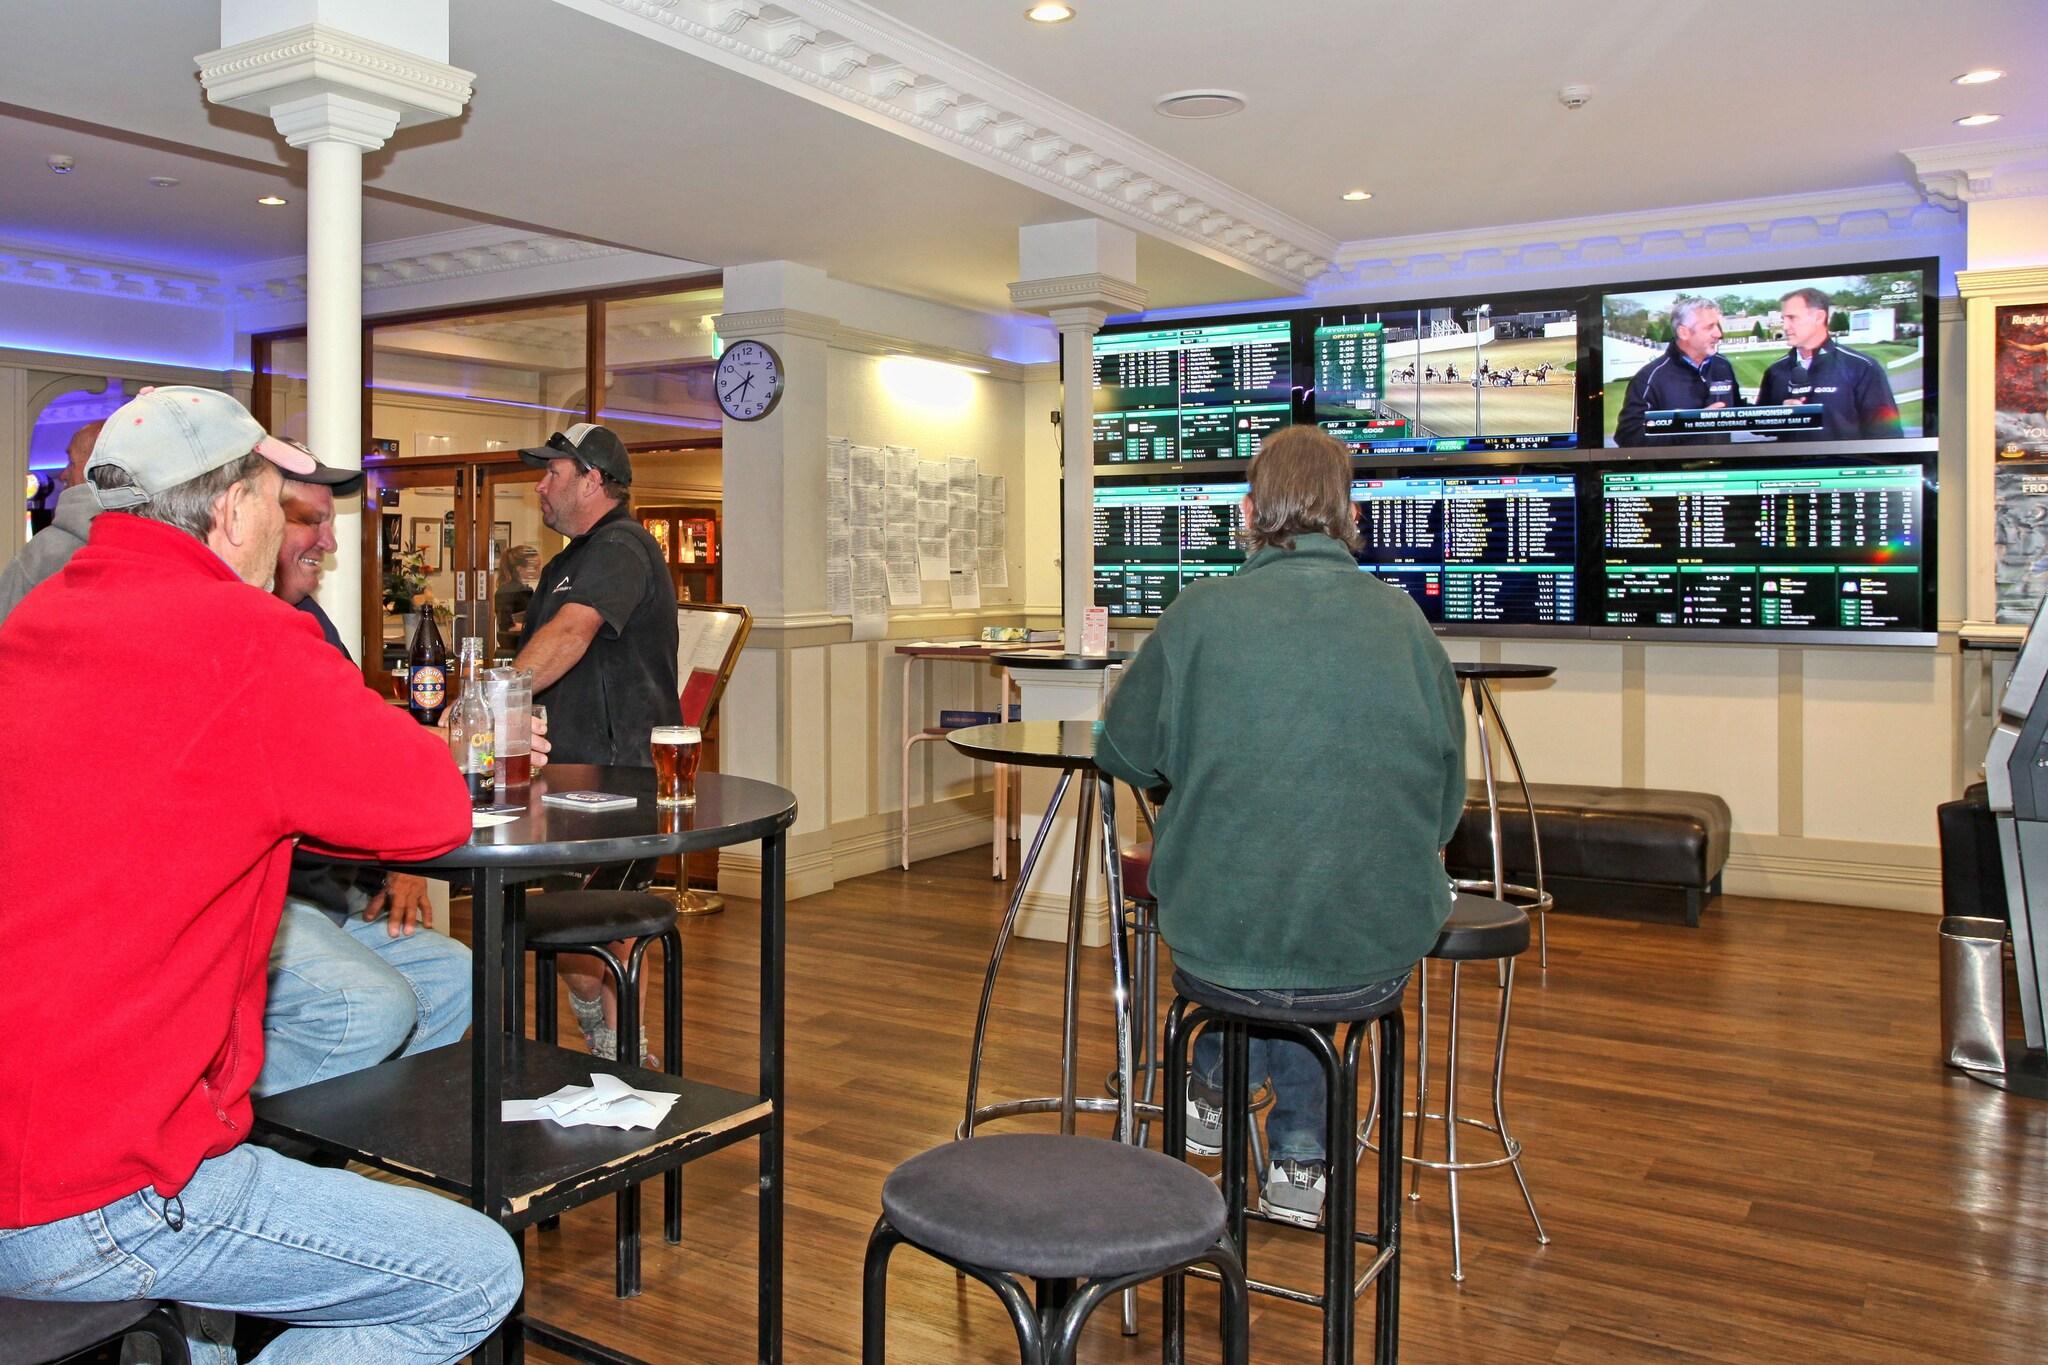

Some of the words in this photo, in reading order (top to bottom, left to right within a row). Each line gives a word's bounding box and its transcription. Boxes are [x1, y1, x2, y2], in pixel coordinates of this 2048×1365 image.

[2012, 314, 2044, 326] Rugby
[742, 347, 753, 355] 12
[759, 351, 762, 359] 1
[732, 353, 740, 361] 11
[723, 365, 734, 373] 10
[769, 376, 776, 384] 3
[1700, 411, 1719, 419] BMW
[1737, 408, 1793, 418] CHAMPIONSHIP
[1656, 419, 1673, 427] GOLF
[1716, 419, 1747, 427] COVERAGE
[2022, 483, 2048, 493] FRO
